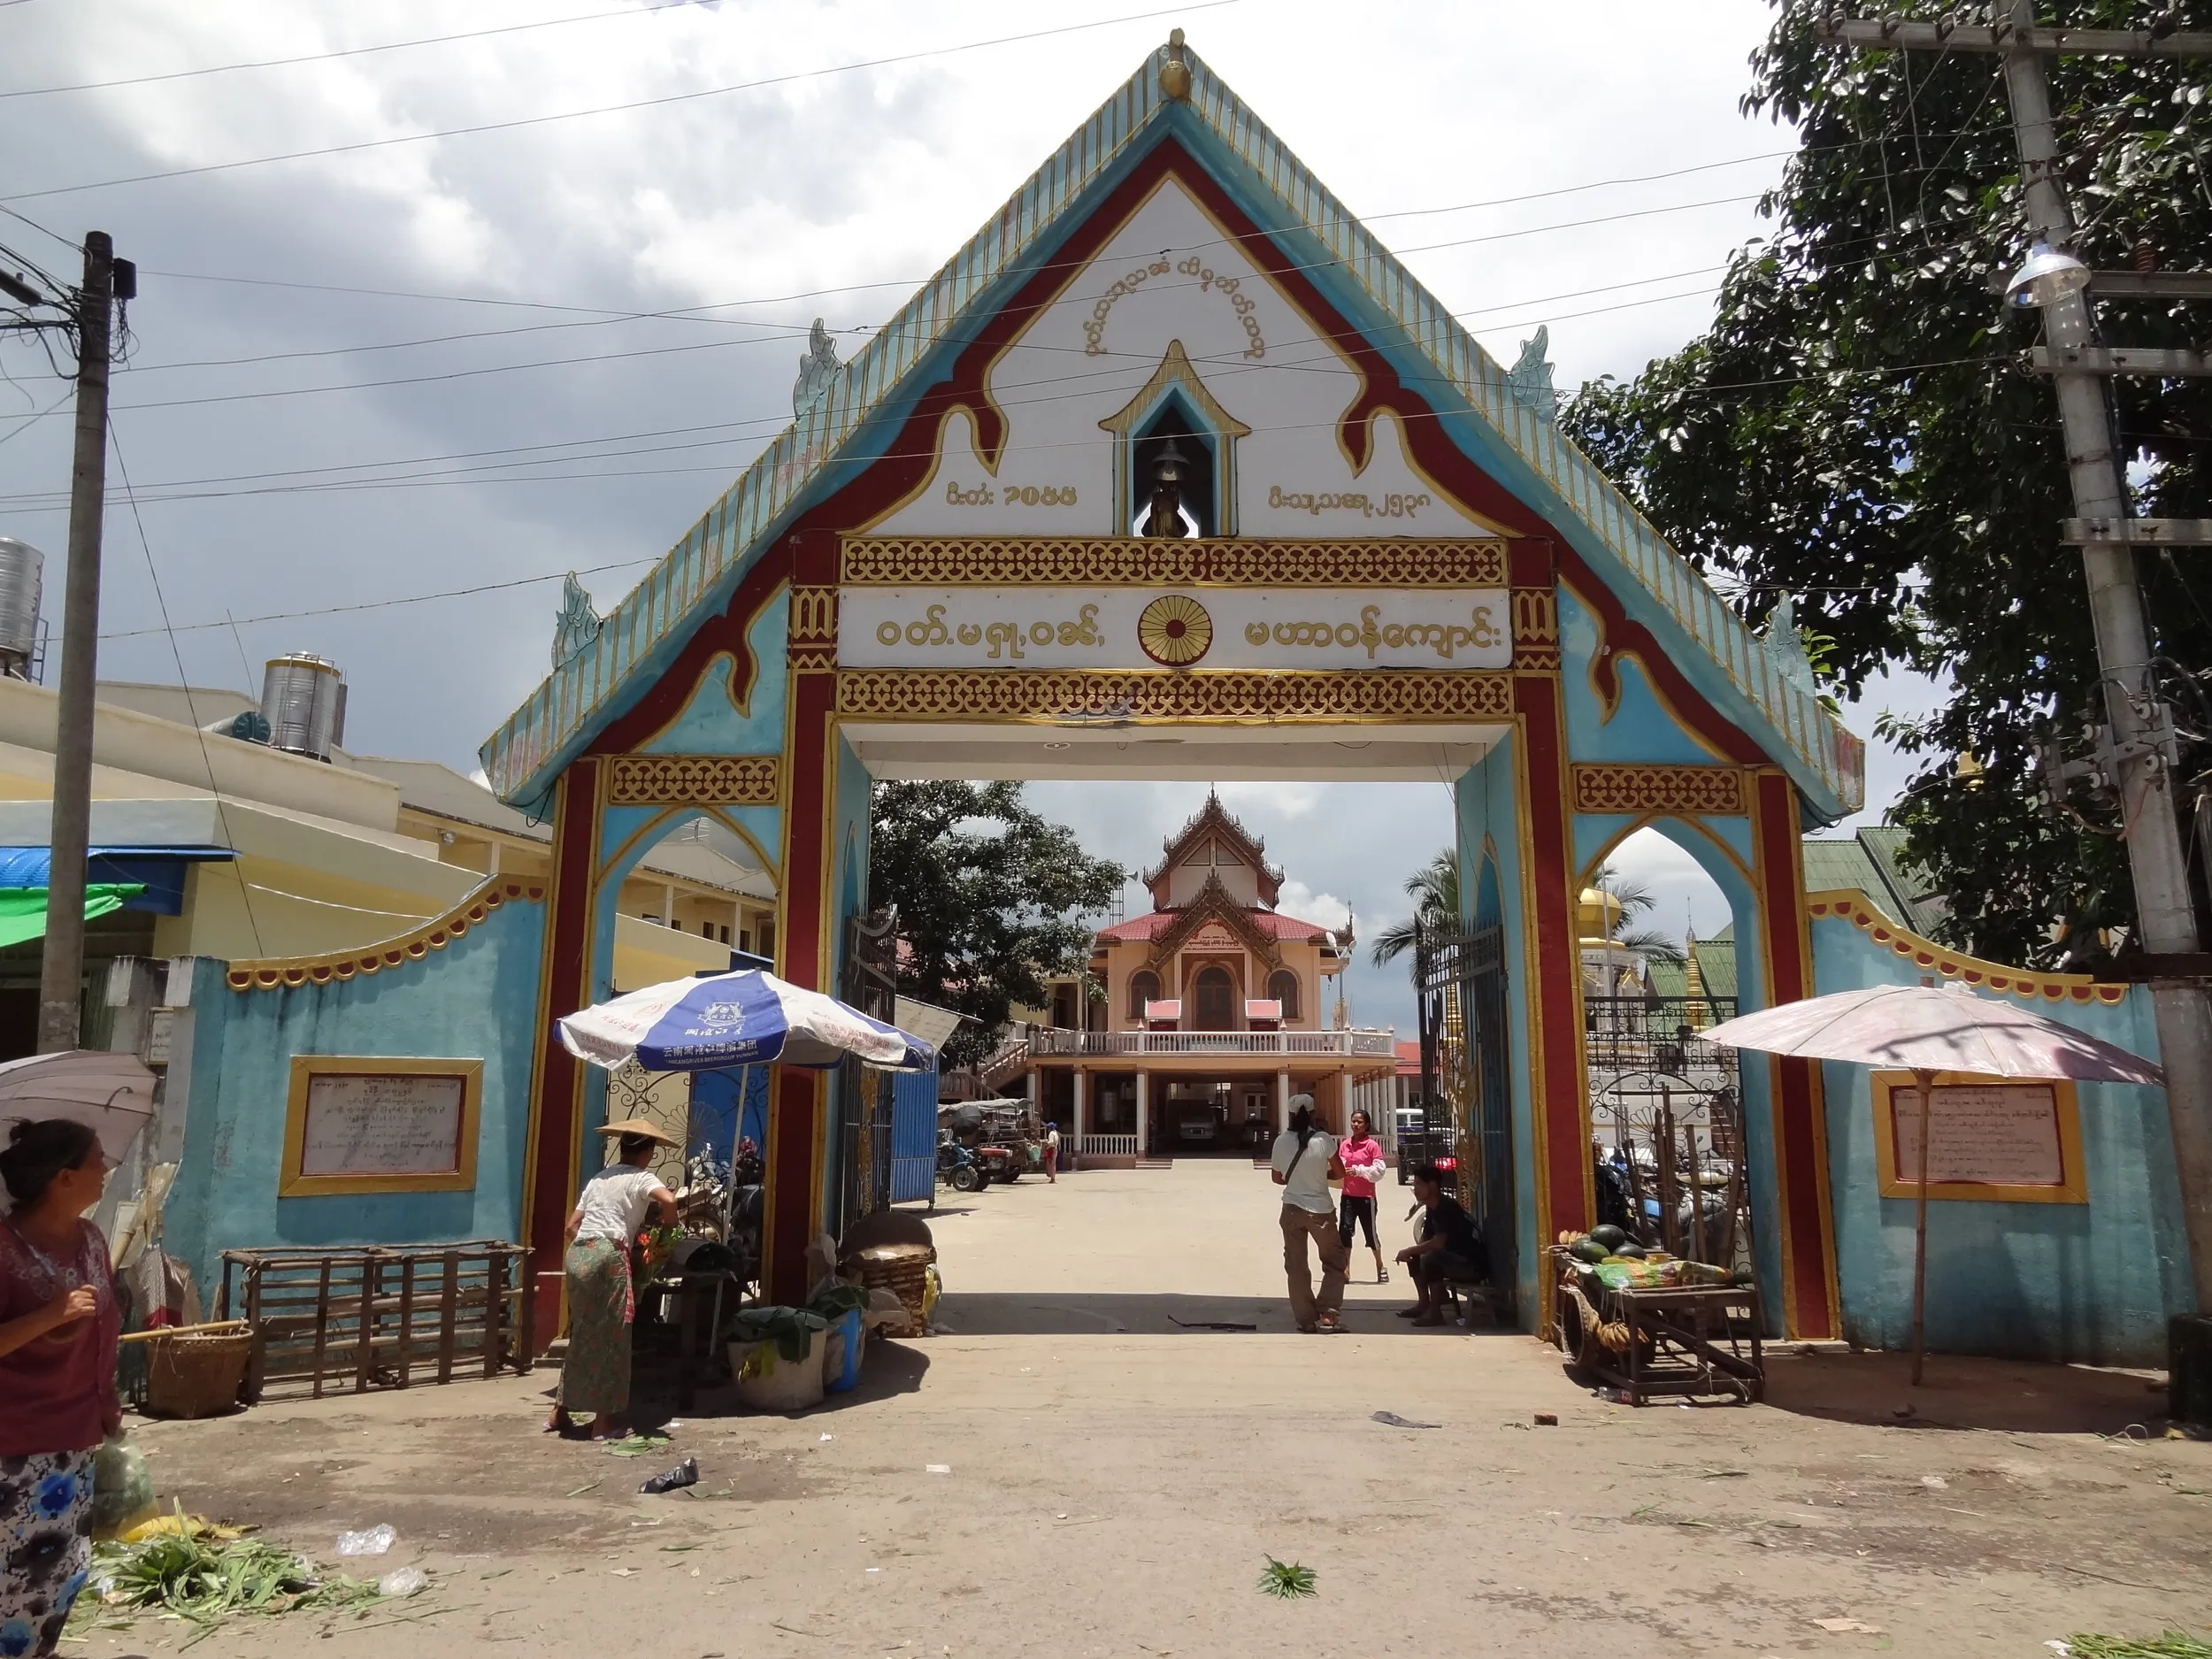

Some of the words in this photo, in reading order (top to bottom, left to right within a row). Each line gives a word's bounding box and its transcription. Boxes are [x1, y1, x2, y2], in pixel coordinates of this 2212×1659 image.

[1245, 605, 1502, 659] မဟာဝန်ကျောင်း
